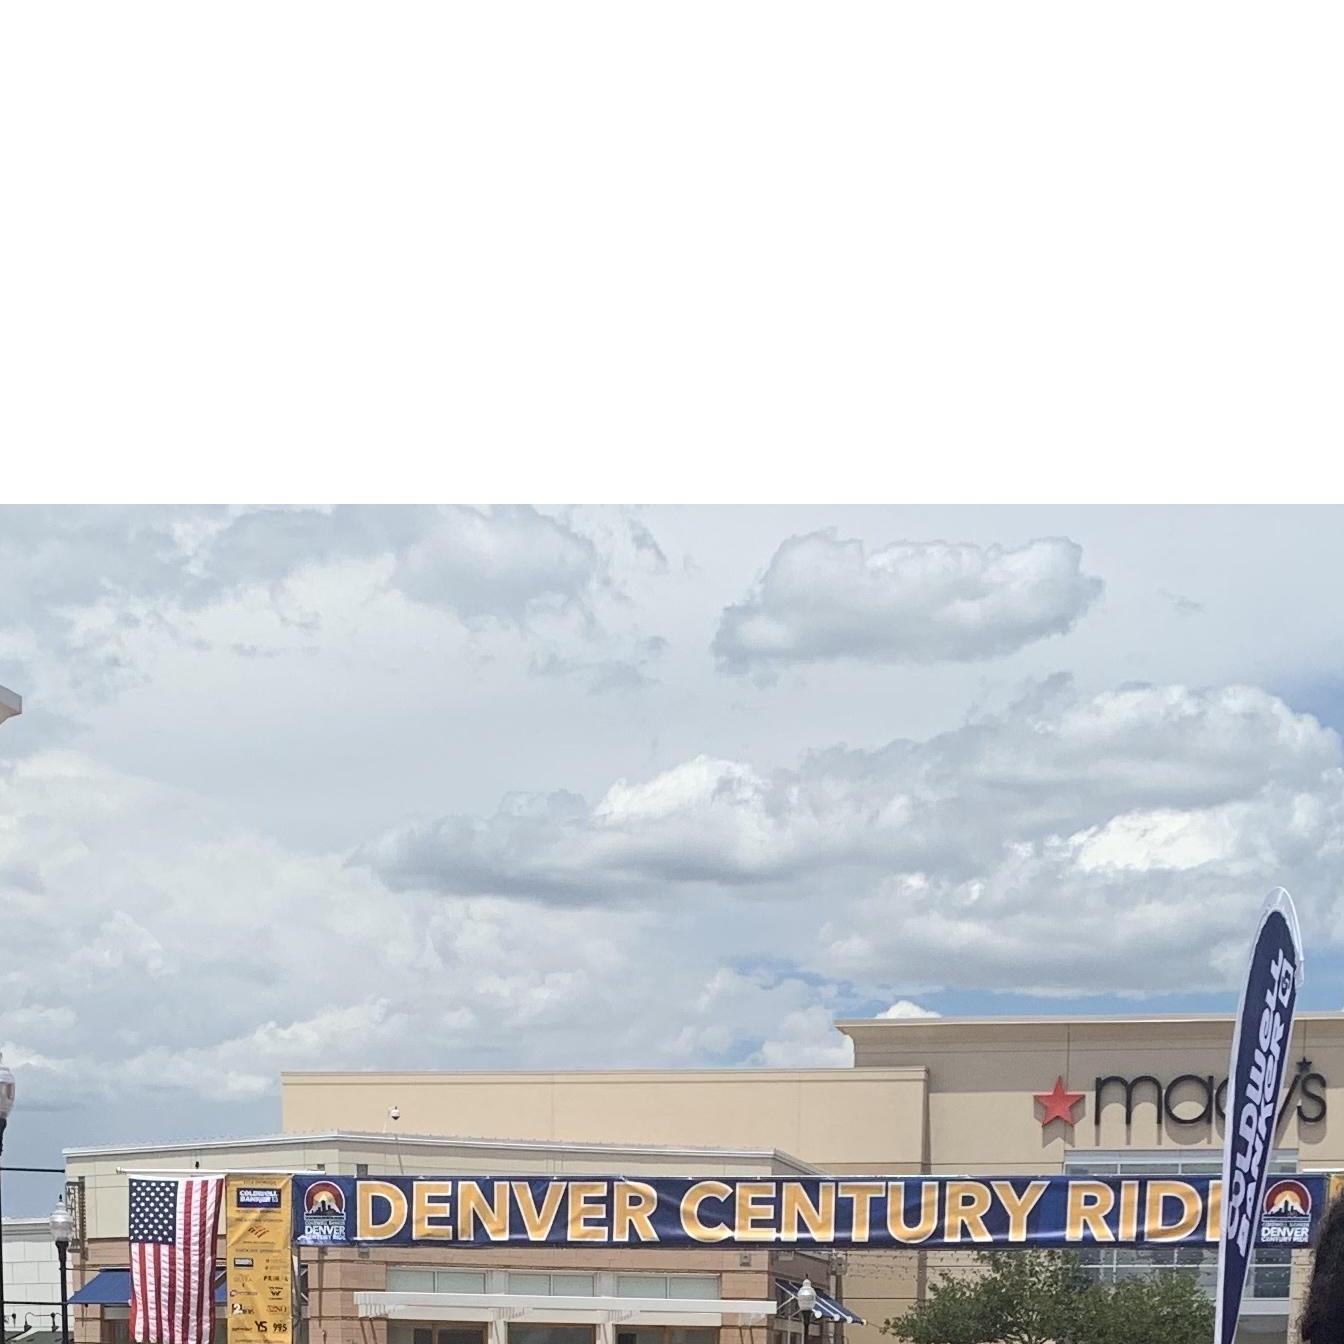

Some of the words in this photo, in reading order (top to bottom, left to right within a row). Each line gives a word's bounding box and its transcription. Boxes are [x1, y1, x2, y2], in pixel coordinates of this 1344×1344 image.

[356, 1181, 660, 1243] DENVER
[679, 1181, 1051, 1244] CENTURY
[304, 1225, 346, 1236] DENVER
[1261, 1226, 1310, 1237] DENVER
